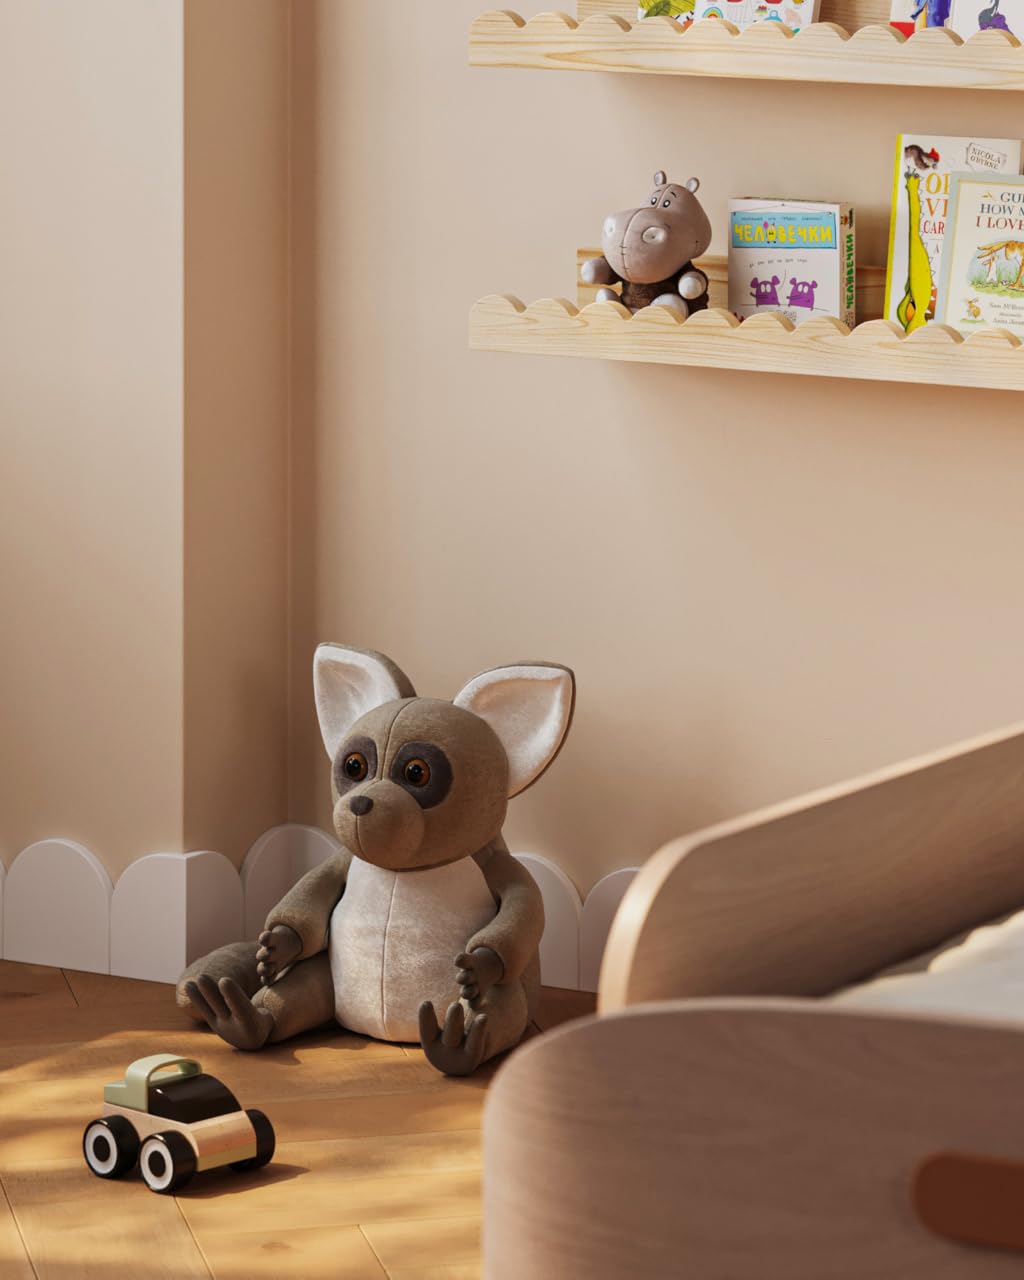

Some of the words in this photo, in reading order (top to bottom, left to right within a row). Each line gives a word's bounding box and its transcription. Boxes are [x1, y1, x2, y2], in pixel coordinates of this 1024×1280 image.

[971, 146, 1002, 164] NICOLA
[980, 203, 1015, 216] HOW
[975, 216, 981, 228] I
[733, 222, 833, 244] ЧЕЛОВЕЧКИ
